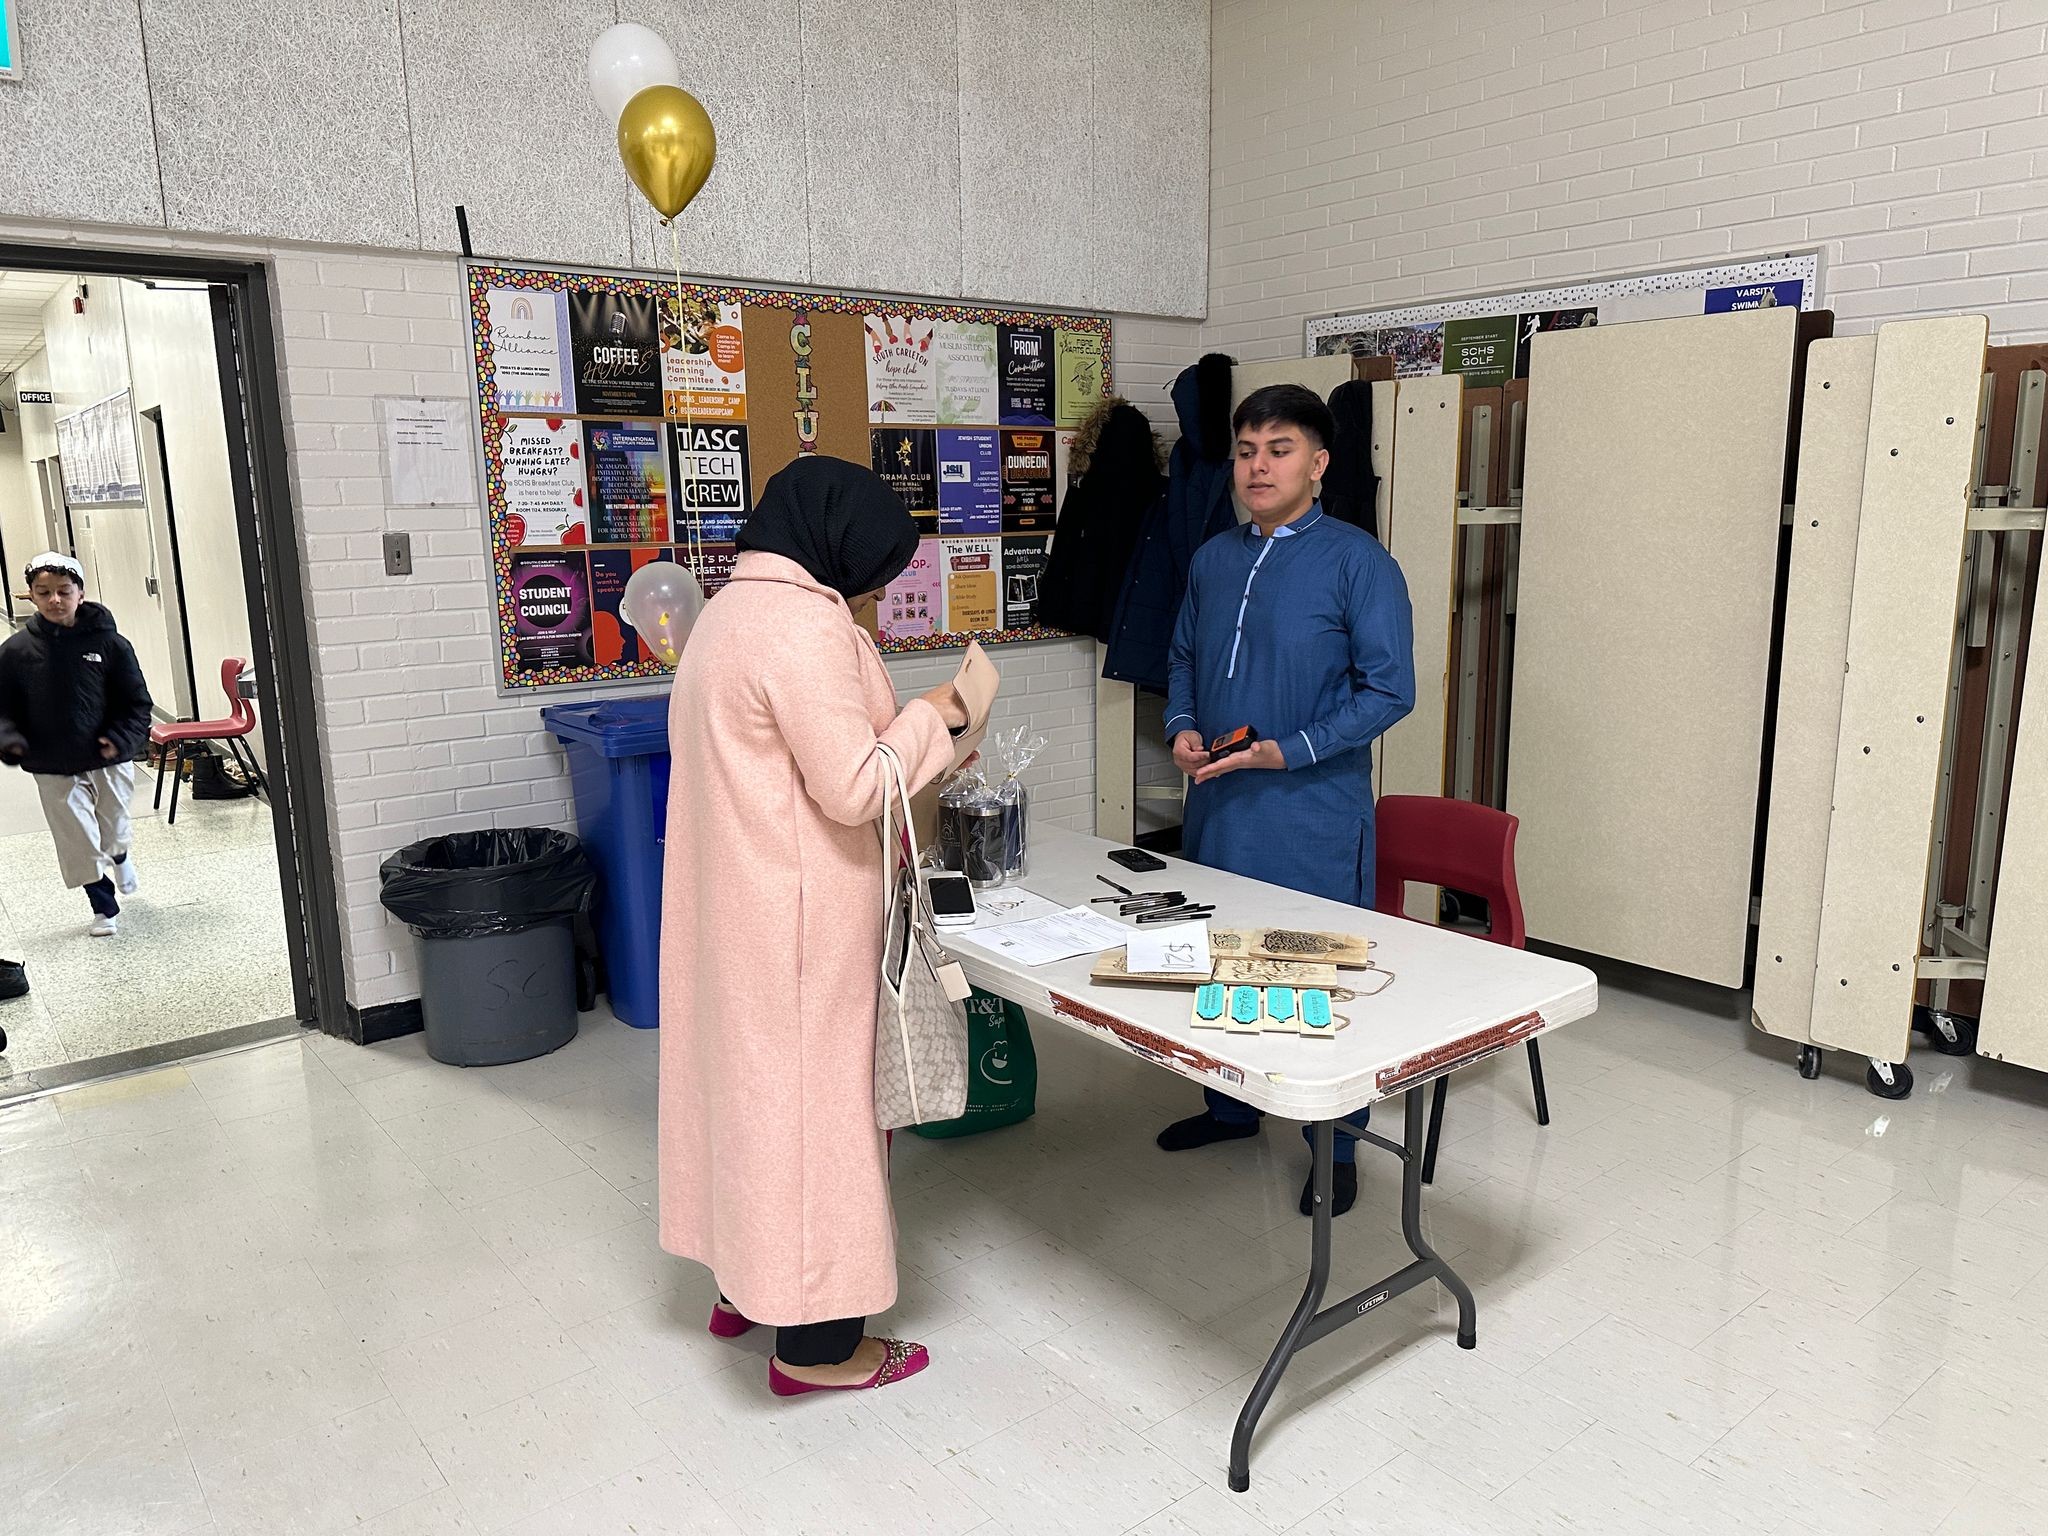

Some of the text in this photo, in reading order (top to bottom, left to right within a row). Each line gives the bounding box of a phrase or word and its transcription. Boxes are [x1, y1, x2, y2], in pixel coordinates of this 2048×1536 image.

[1737, 286, 1776, 298] VARSITY
[494, 326, 551, 341] Rainbow
[493, 339, 559, 355] Alliance
[939, 342, 963, 350] MUSLIM
[1014, 340, 1039, 356] PROM
[1085, 347, 1101, 355] CLUB
[1461, 346, 1495, 357] SCHS
[593, 346, 639, 366] COFFEE
[666, 357, 712, 366] Leadership
[873, 347, 929, 367] SOUTH CARLETON
[1461, 356, 1494, 366] GOLF
[666, 366, 705, 376] Planning
[886, 360, 917, 376] hope club
[1008, 359, 1046, 375] Committee
[667, 375, 714, 384] Committee
[790, 324, 818, 456] CLU
[22, 393, 51, 402] OFFICE
[520, 437, 551, 446] MISSED
[677, 428, 740, 451] TASC
[509, 447, 563, 456] BREAKFAST?
[504, 457, 571, 466] RUNNING LATE?
[685, 456, 735, 475] TECH
[1008, 455, 1047, 469] DUNGEON
[518, 467, 558, 476] HUNGRY?
[546, 489, 562, 497] help!
[685, 483, 739, 503] CREW
[947, 544, 993, 554] The WELL
[1004, 547, 1042, 556] Adventure
[684, 554, 739, 564] LET'S PLA
[604, 571, 617, 579] you
[687, 566, 737, 575] TOGETHE
[518, 586, 572, 600] STUDENT
[520, 603, 572, 617] COUNCIL
[1066, 1002, 1167, 1048] 6-FOOT COMMERCIAL FOLDING TABLE
[1361, 1293, 1385, 1311] LIFETIME
